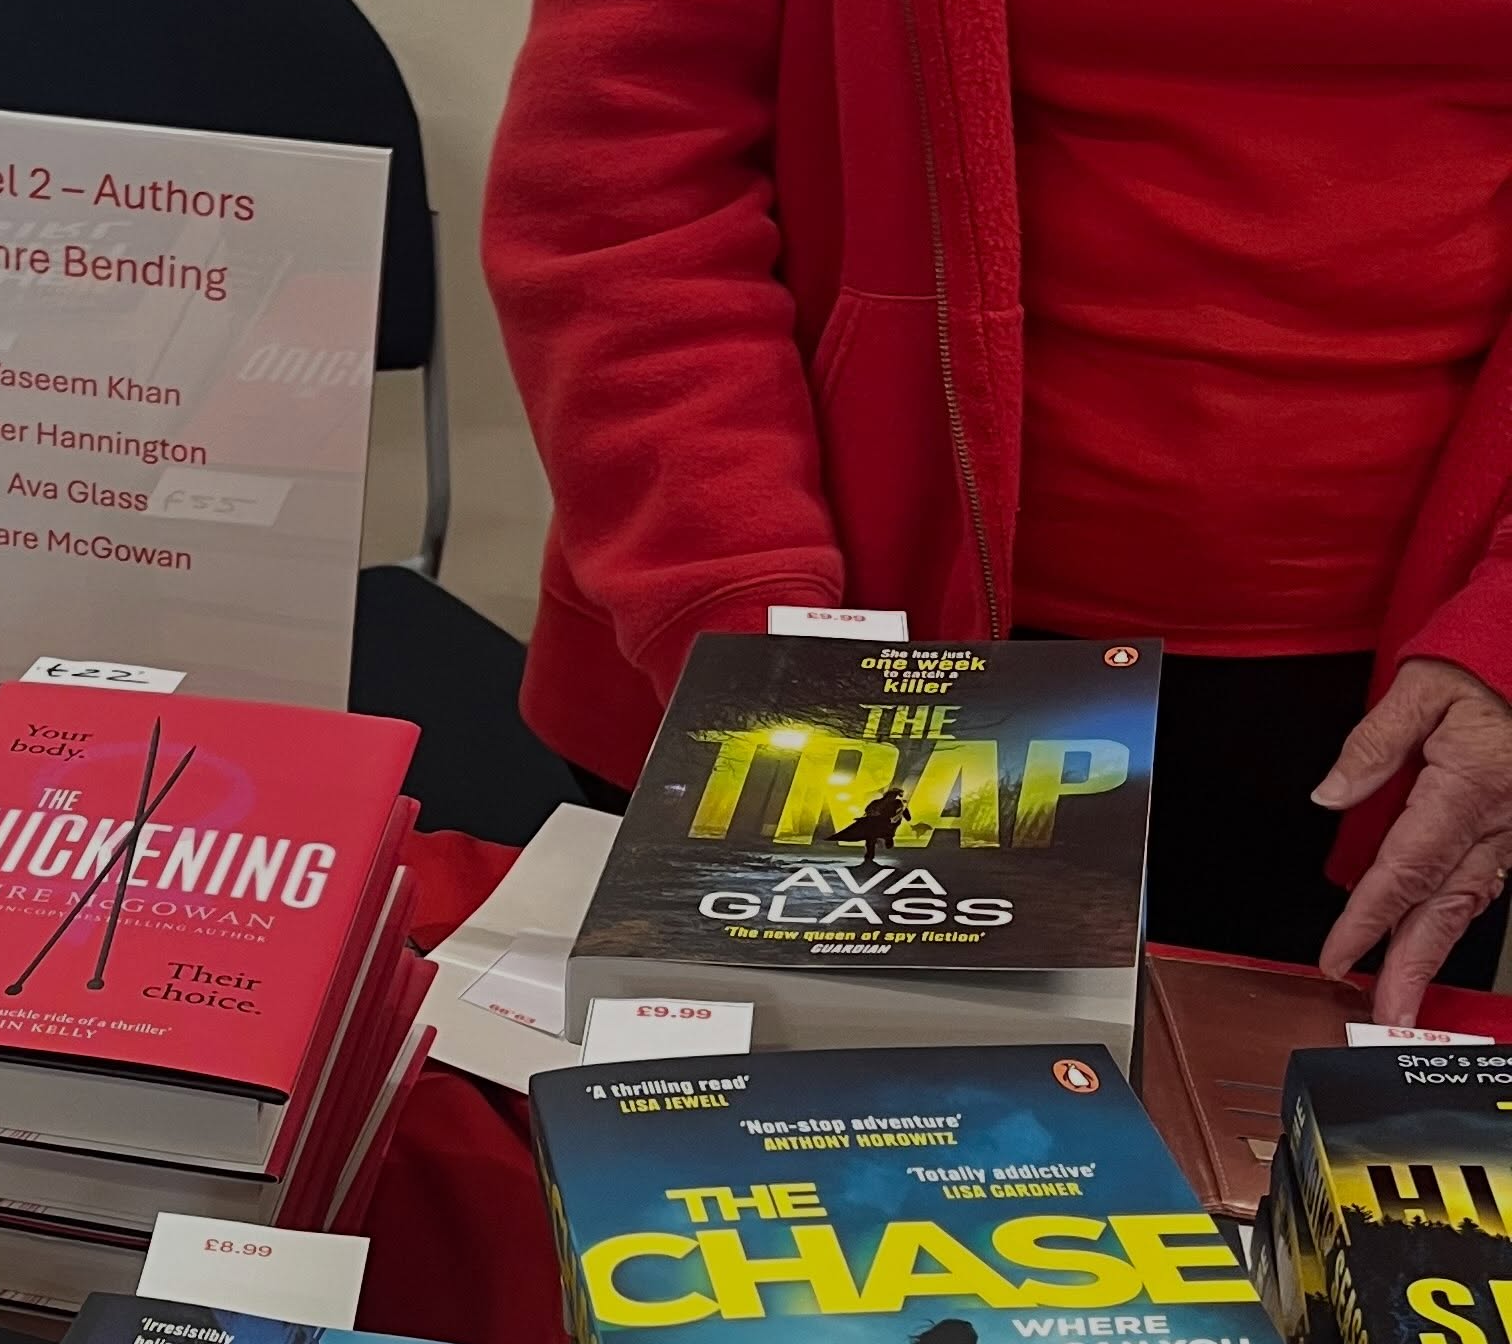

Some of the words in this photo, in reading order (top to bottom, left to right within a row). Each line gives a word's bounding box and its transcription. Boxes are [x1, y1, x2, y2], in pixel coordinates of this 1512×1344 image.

[29, 167, 52, 200] 2
[93, 173, 255, 221] Authors
[64, 245, 228, 302] Bending
[107, 374, 181, 407] Khan
[36, 423, 206, 465] Hannington
[7, 473, 58, 501] Ava
[67, 479, 149, 511] Glass
[48, 529, 192, 570] McGowan
[806, 612, 866, 622] £9.99
[860, 658, 908, 670] one
[917, 657, 986, 671] week
[881, 649, 909, 659] She
[912, 650, 939, 659] has
[941, 650, 972, 661] just
[884, 679, 953, 694] killer
[27, 723, 94, 743] Your
[859, 703, 962, 740] THE
[9, 738, 87, 762] body.
[37, 787, 83, 812] THE
[687, 729, 1131, 849] TRAP
[772, 867, 948, 895] AVA
[66, 890, 276, 931] McGOWAN
[699, 891, 1014, 926] GLASS
[763, 929, 799, 940] new
[803, 930, 856, 942] queen
[860, 930, 881, 942] of
[884, 931, 917, 944] spy
[810, 943, 892, 955] GUARDIAN
[167, 961, 262, 992] Their
[142, 983, 263, 1016] choice.
[636, 1004, 713, 1021] £9.99
[30, 1023, 97, 1039] KELLY
[1388, 1028, 1451, 1043] £9.99
[1397, 1055, 1471, 1067] She's
[611, 1079, 694, 1097] thrilling
[698, 1073, 751, 1092] read'
[1404, 1071, 1468, 1084] Now
[619, 1097, 661, 1113] LISA
[664, 1093, 730, 1112] JEWELL
[739, 1117, 846, 1136] 'Non-stop
[851, 1113, 962, 1132] adventure'
[763, 1134, 851, 1153] ANTHONY
[857, 1131, 958, 1149] HOROWITZ
[906, 1164, 986, 1185] 'Totally
[991, 1162, 1097, 1182] addictive'
[665, 1181, 828, 1224] THE
[942, 1182, 986, 1200] LISA
[989, 1182, 1083, 1199] GARDNER
[203, 1237, 273, 1258] £8.99
[579, 1212, 1261, 1328] CHASE
[1011, 1314, 1171, 1339] WHERE
